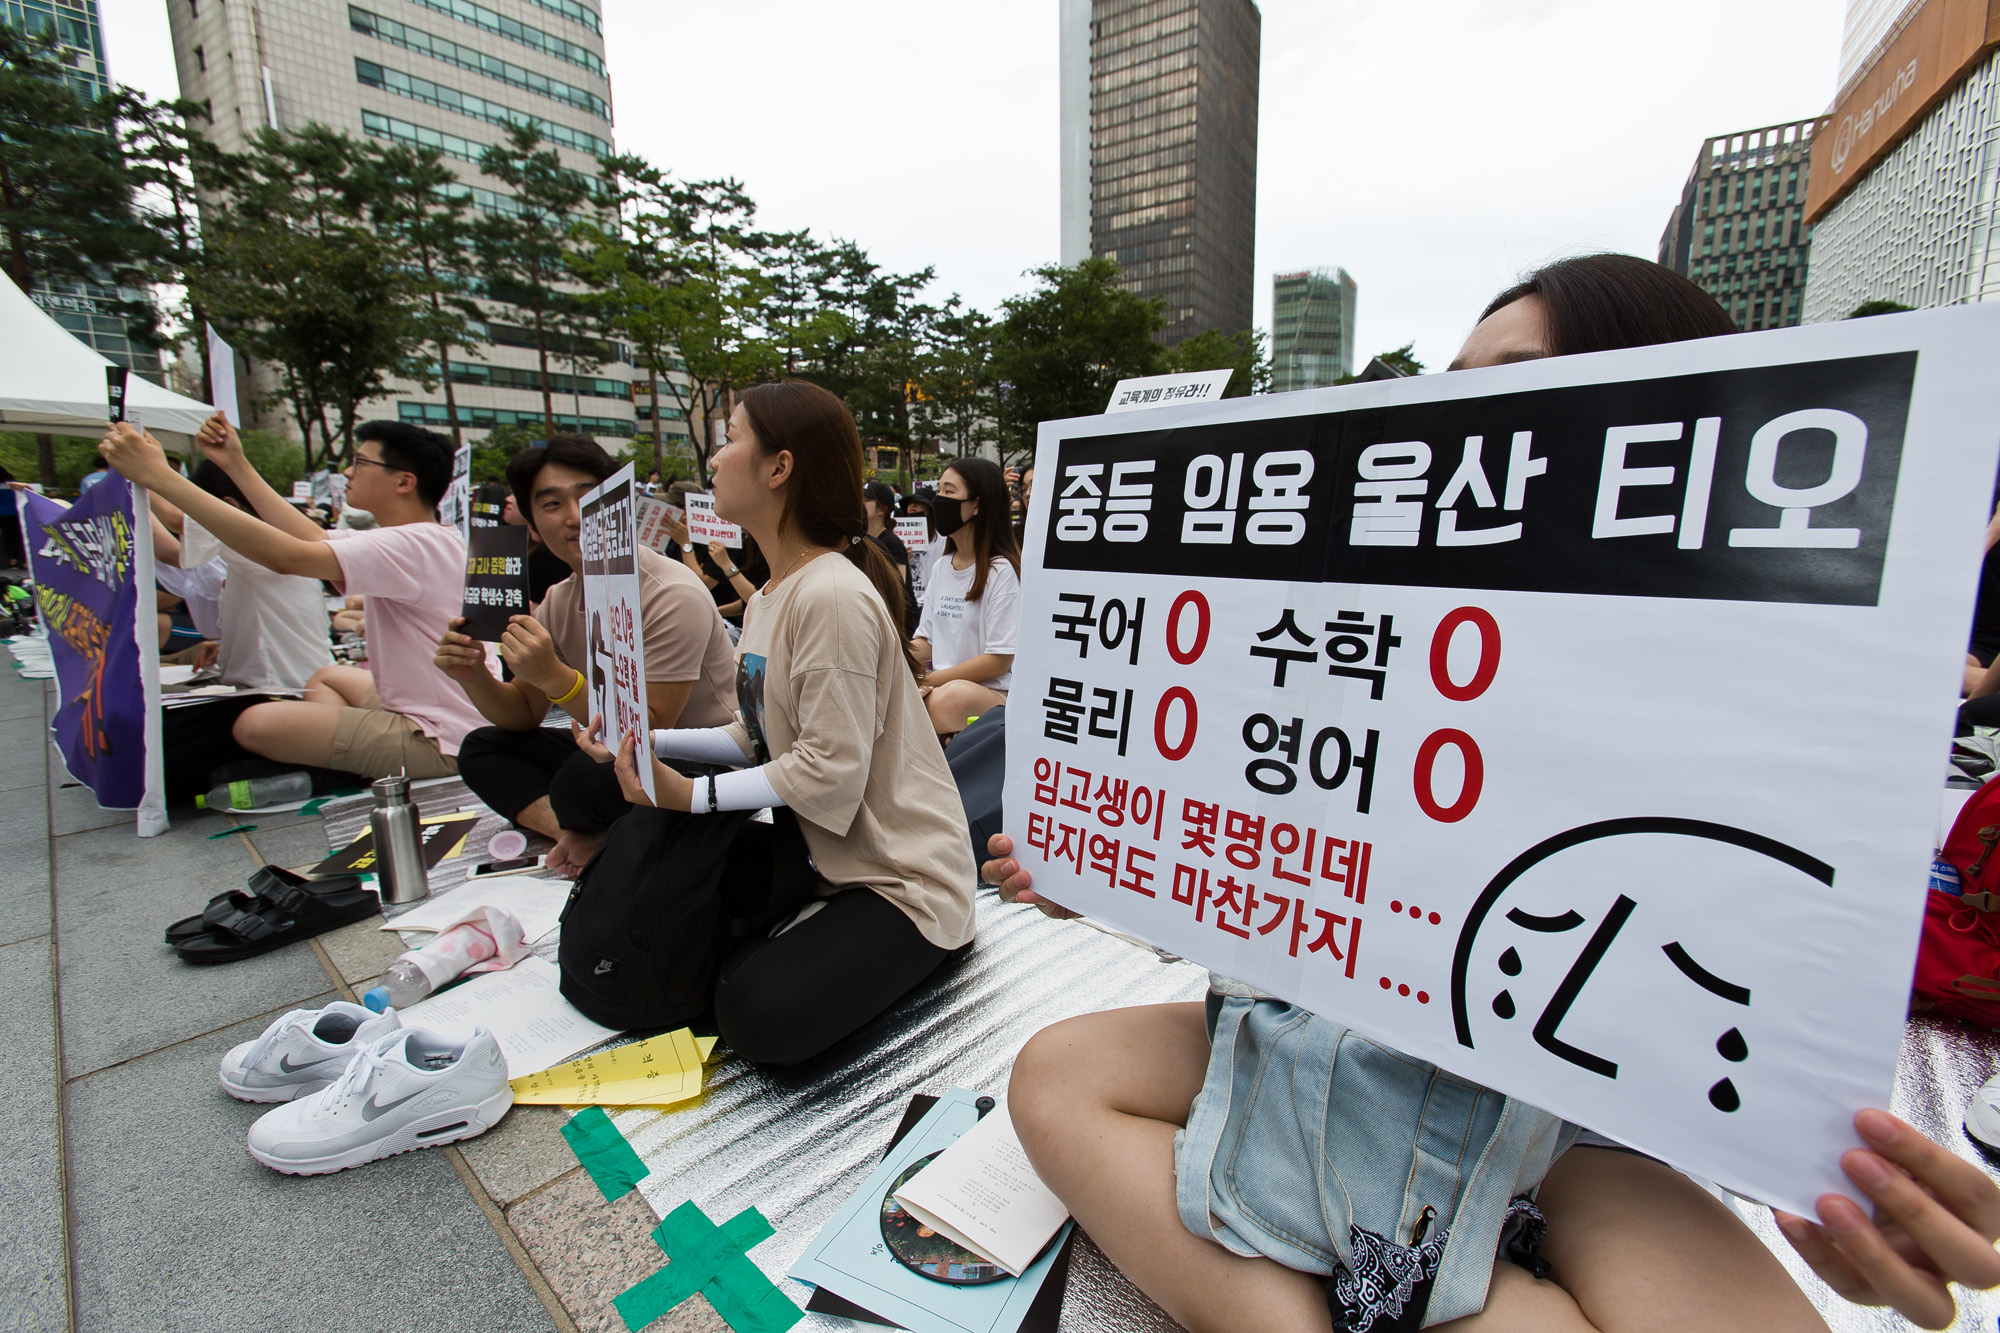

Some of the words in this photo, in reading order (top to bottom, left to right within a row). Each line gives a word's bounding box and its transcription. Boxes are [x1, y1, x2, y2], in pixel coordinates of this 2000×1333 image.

[1850, 58, 1918, 148] Hanwha
[1118, 388, 1163, 406] 교육계의
[1163, 383, 1212, 401] 정유라!!
[1055, 459, 1156, 543] 중등
[1180, 449, 1316, 546] 임용
[1349, 430, 1548, 548] 울산
[1591, 407, 1869, 550] 티오
[481, 587, 504, 606] 학생수
[505, 588, 523, 608] 감축
[490, 556, 522, 575] 증원하라
[1051, 592, 1147, 666] 국어
[1165, 589, 1211, 666] 0
[1249, 608, 1403, 701] 수학
[1429, 605, 1502, 702] 0
[1041, 676, 1135, 757] 물리
[1153, 685, 1199, 762] 0
[1241, 712, 1381, 815] 영어
[1412, 727, 1485, 824] 0
[1033, 756, 1167, 842] 임고생이
[1026, 811, 1157, 900] 타지역도
